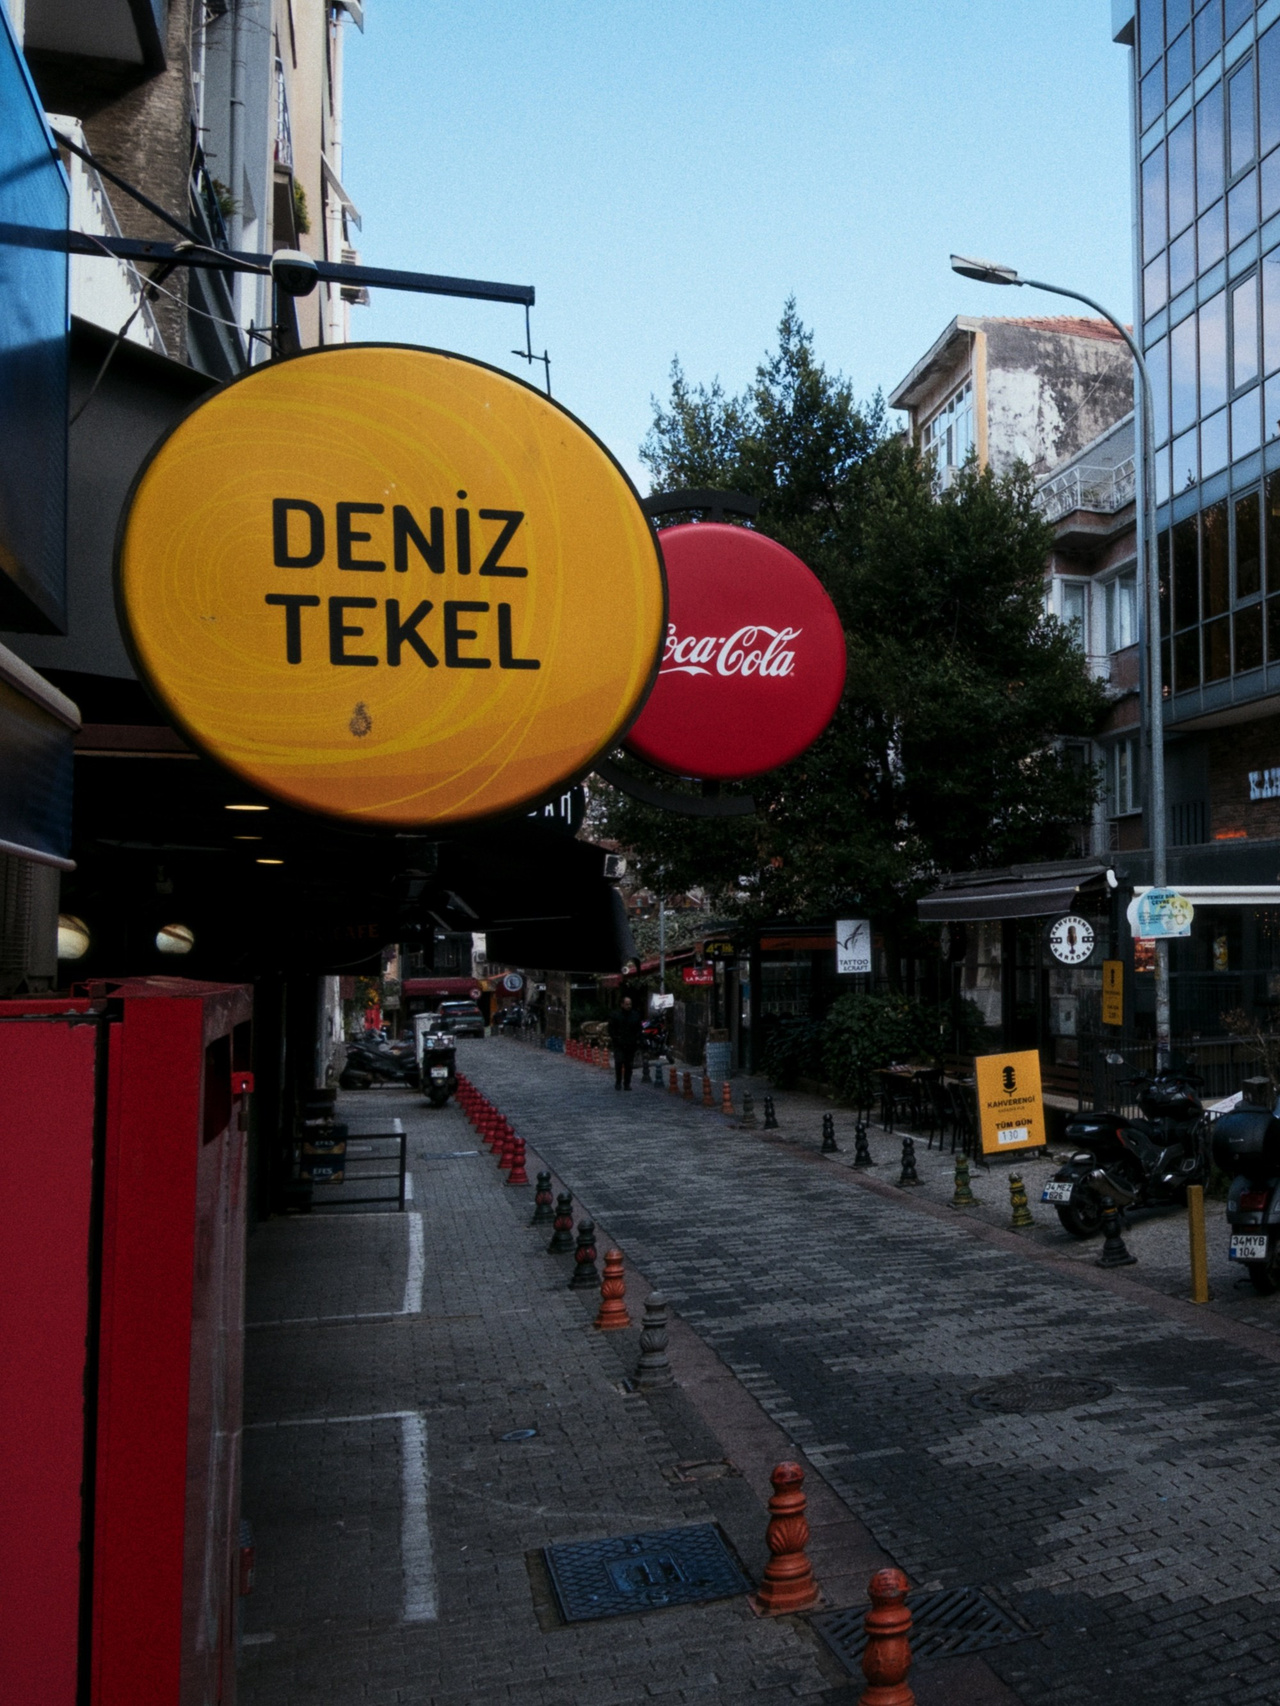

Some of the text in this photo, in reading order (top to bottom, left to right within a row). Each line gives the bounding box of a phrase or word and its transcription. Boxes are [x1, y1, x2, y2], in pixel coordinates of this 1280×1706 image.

[272, 489, 528, 578] DENİZ
[264, 593, 541, 670] TEKEL
[659, 622, 803, 678] oca-Cola
[986, 1095, 1036, 1109] KAHVERENGİ
[995, 1117, 1033, 1130] TÜM GÜN
[1045, 1183, 1055, 1191] 34
[1239, 1247, 1256, 1257] 104
